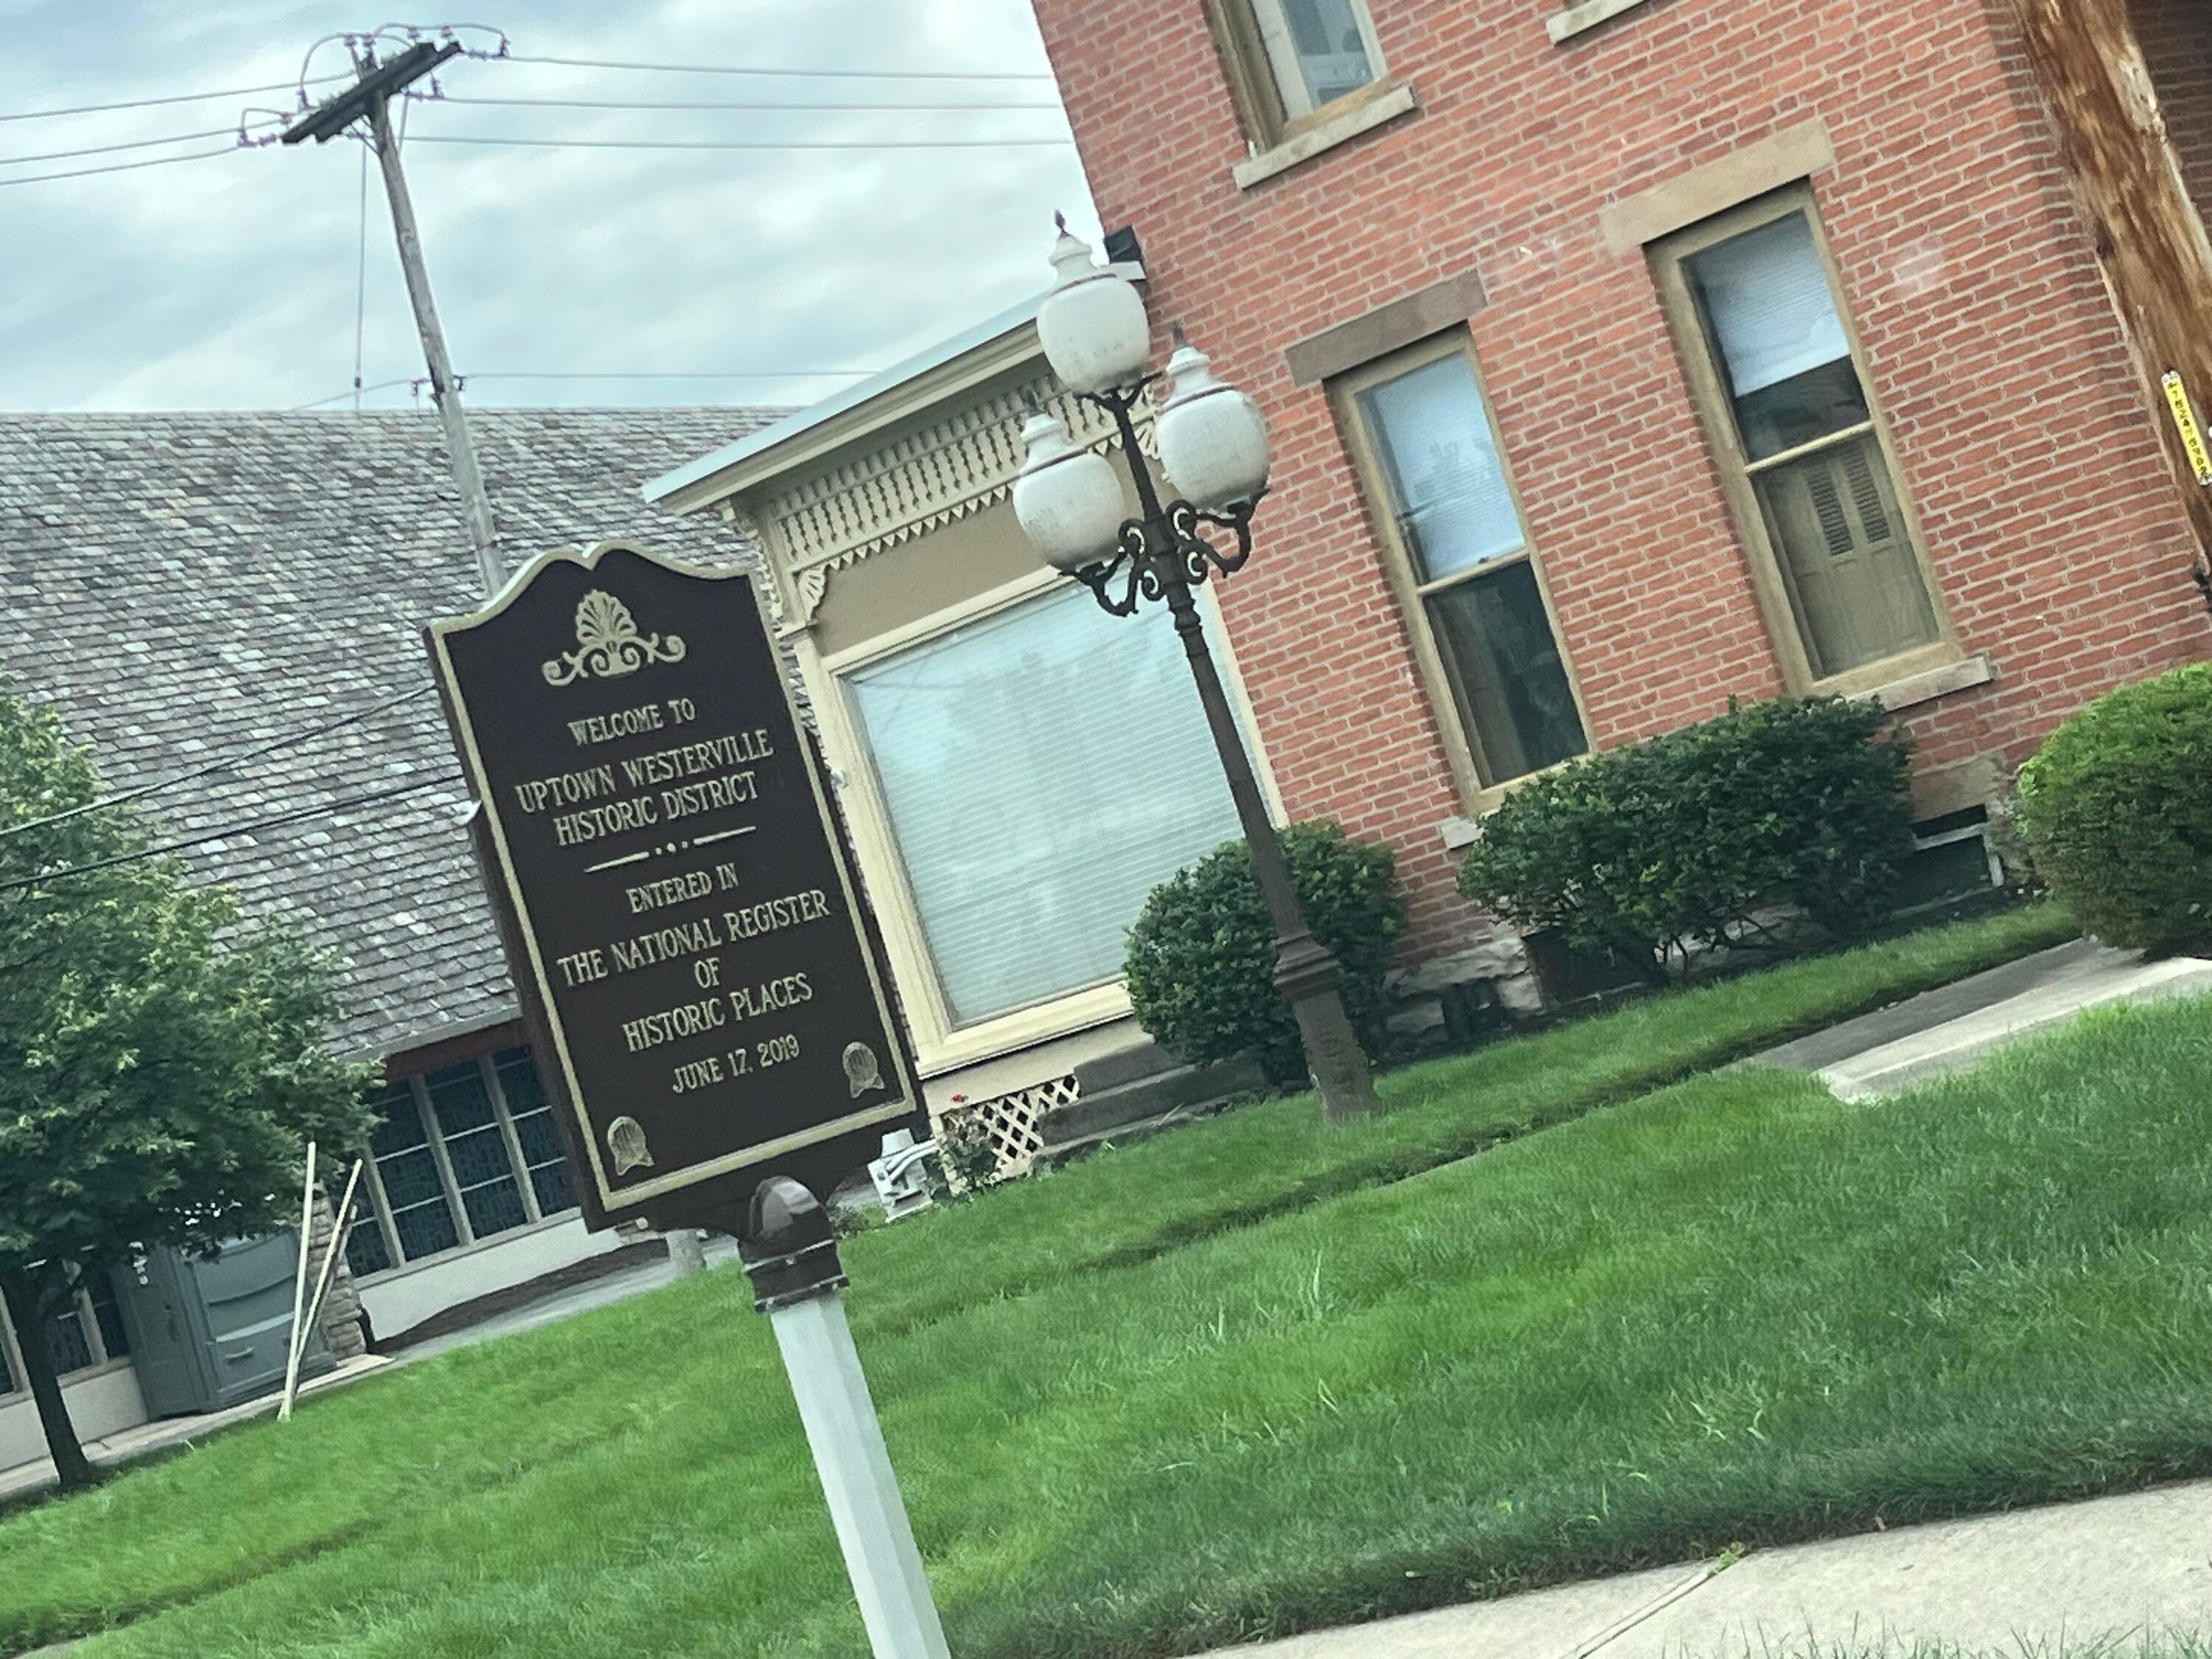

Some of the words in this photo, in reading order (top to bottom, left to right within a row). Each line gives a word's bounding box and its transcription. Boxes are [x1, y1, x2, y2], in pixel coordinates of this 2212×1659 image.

[567, 704, 664, 745] WELCOME
[667, 698, 695, 723] TO
[514, 765, 616, 813] UPTOWN
[621, 729, 773, 787] WESTERVILLE
[553, 796, 658, 846] HISTORIC
[661, 771, 757, 819] DISTRICT
[625, 871, 712, 913] ENTERED
[716, 863, 738, 890] IN
[557, 949, 608, 986] THE
[611, 918, 722, 972] NATIONAL
[723, 890, 830, 941] REGISTER
[694, 957, 720, 988] OF
[622, 998, 725, 1052] HISTORIC
[729, 973, 812, 1020] PLACES
[672, 1057, 723, 1093] JUNE
[757, 1034, 799, 1067] 2019
